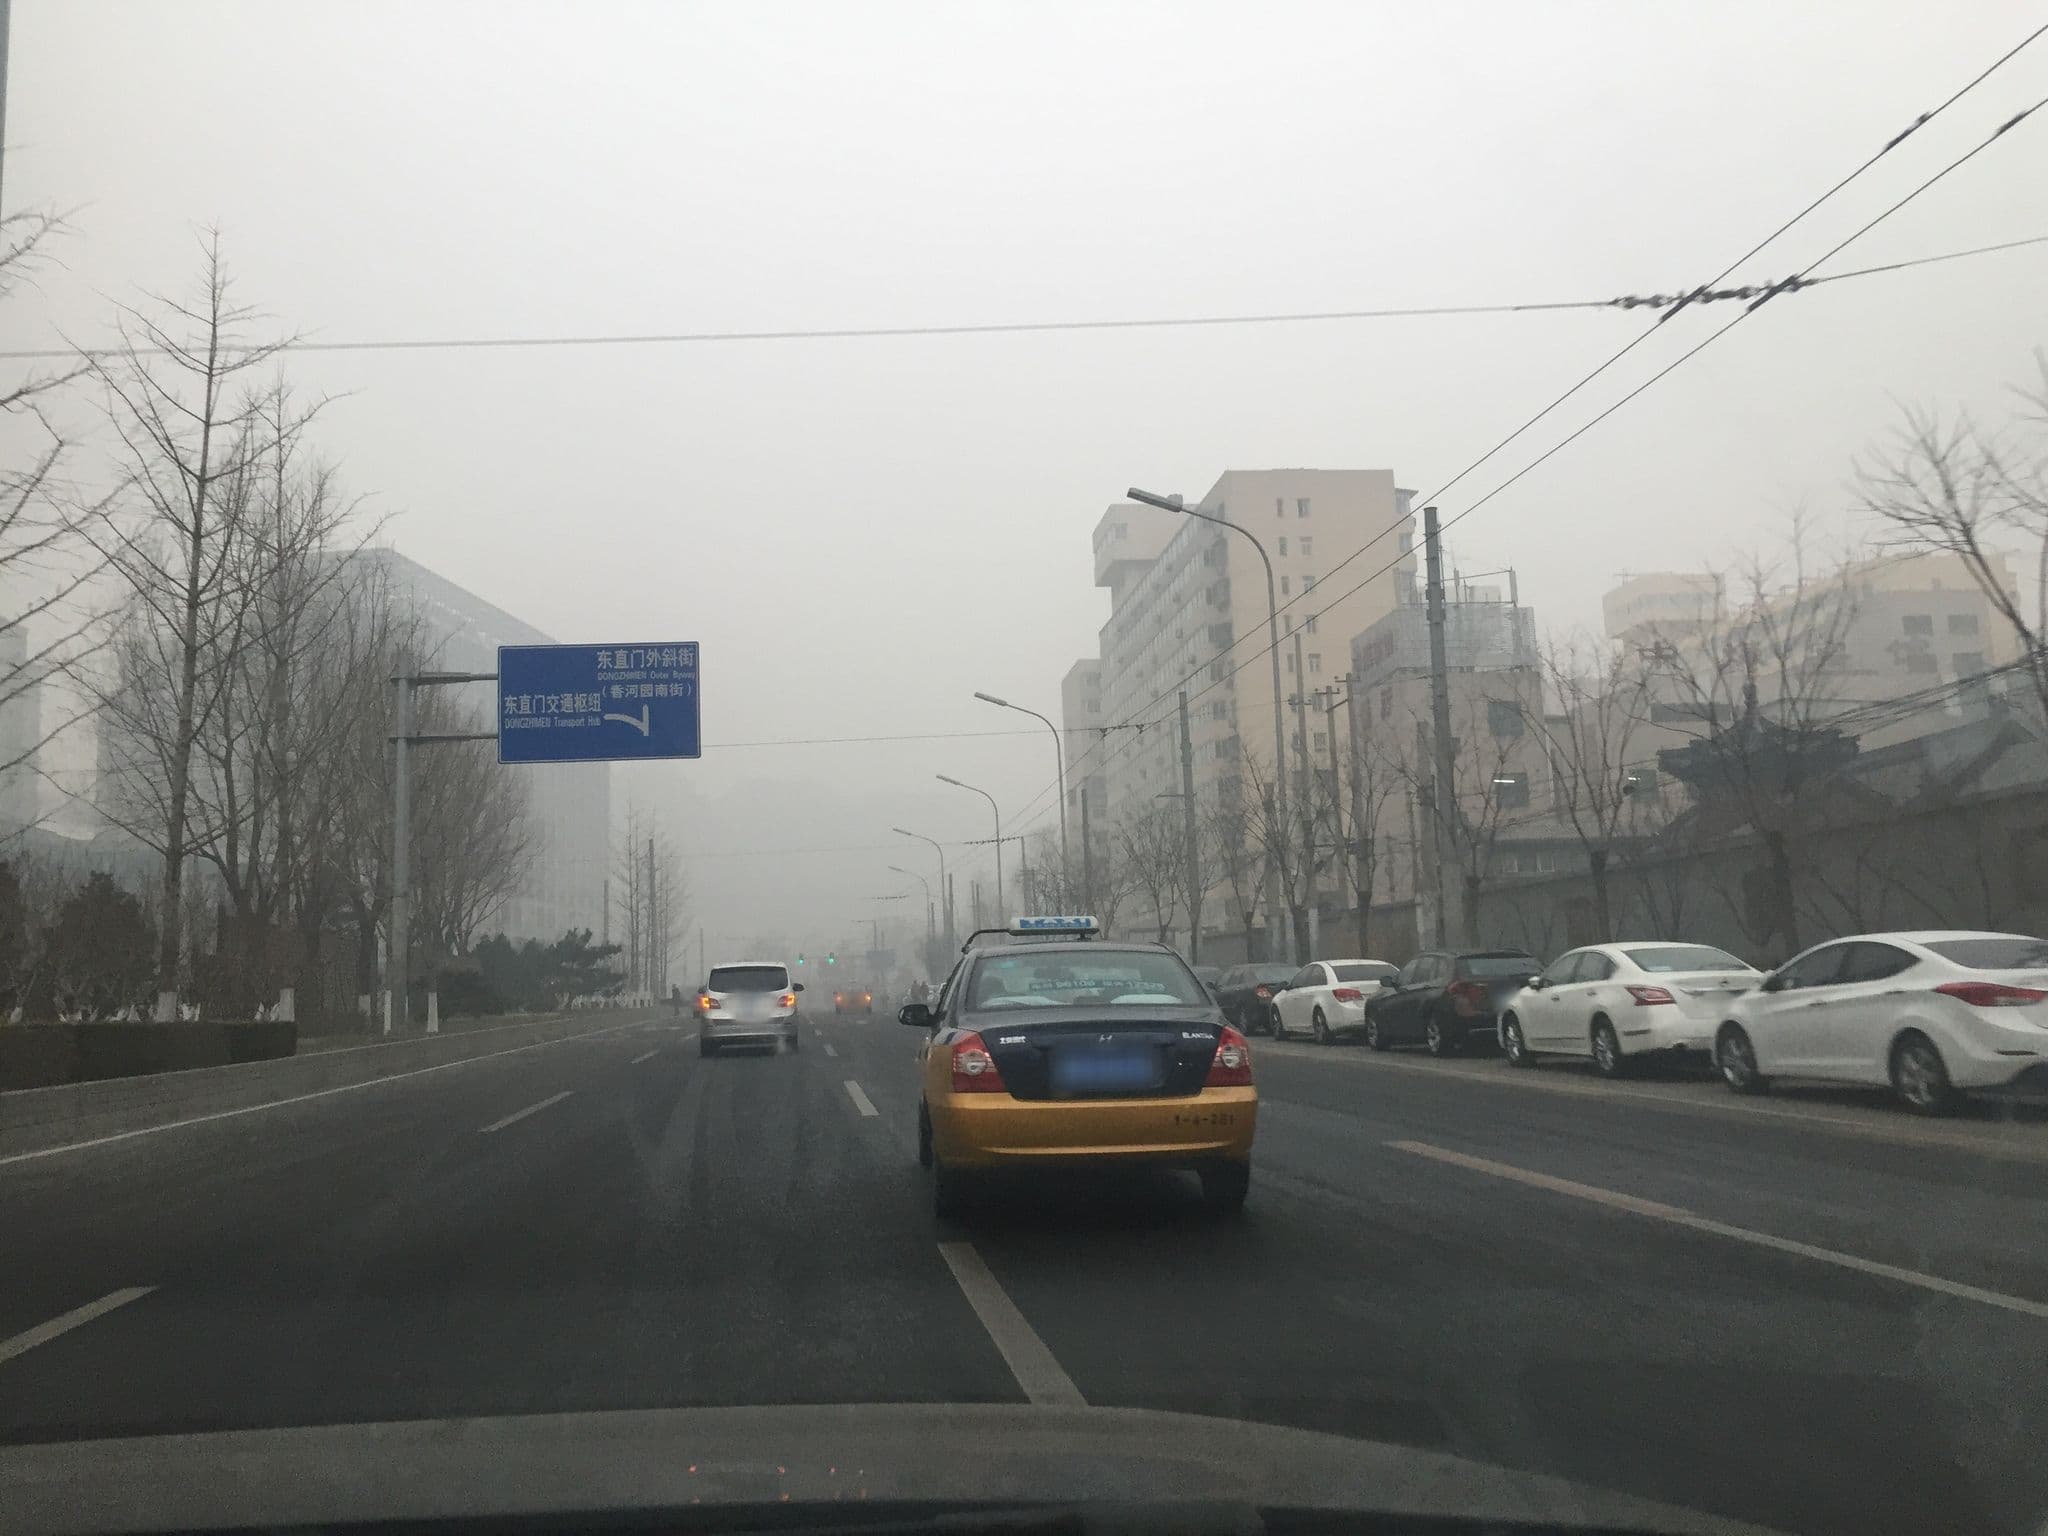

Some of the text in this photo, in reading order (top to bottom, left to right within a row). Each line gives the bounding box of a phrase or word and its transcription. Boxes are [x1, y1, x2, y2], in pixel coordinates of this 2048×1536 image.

[597, 648, 695, 669] 东直门外斜街
[504, 693, 602, 714] 东直门交通枢纽
